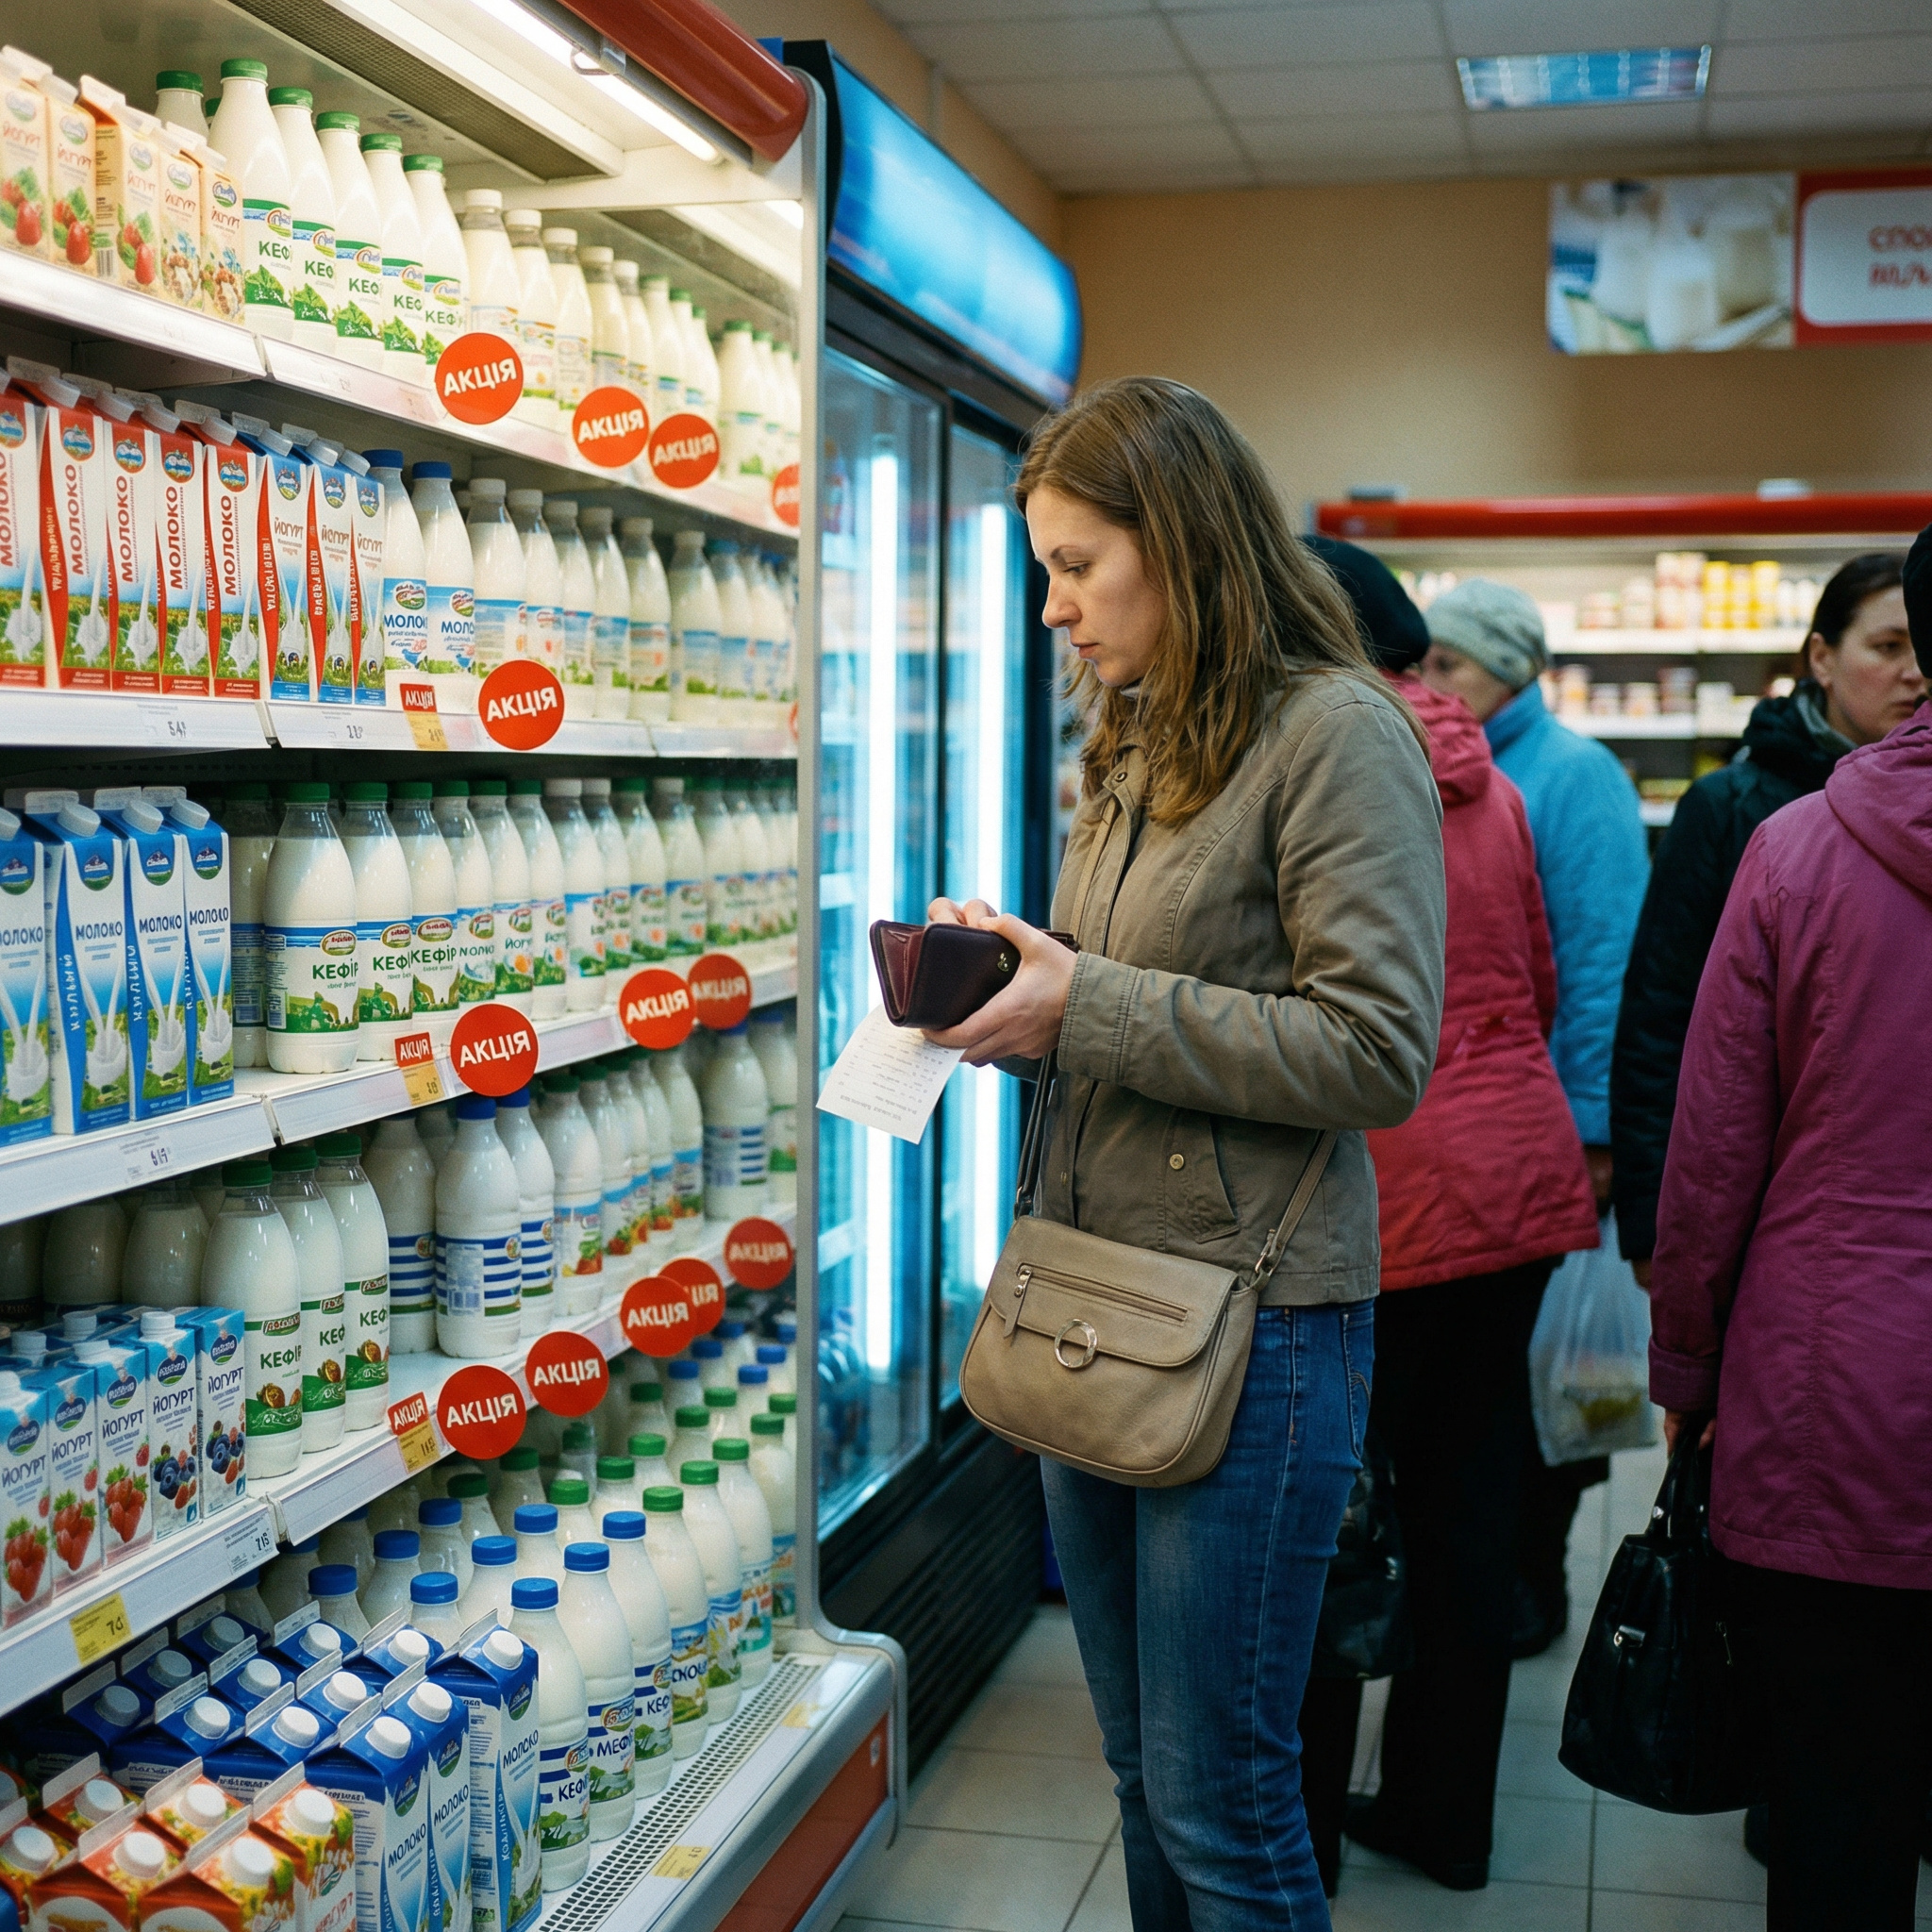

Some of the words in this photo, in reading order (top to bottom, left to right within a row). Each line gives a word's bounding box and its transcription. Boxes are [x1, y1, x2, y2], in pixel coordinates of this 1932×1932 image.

[443, 358, 518, 397] АКЦІЯ
[577, 408, 645, 444] АКЦІЯ
[653, 432, 717, 466] АКЦІЯ
[65, 464, 84, 575] МОЛОКО
[116, 475, 133, 583] МОЛОКО
[165, 486, 183, 590] МОЛОКО
[221, 495, 236, 596] МОЛОКО
[486, 686, 558, 723] АКЦІЯ
[75, 921, 123, 941] МОЛОКО
[139, 914, 182, 934] МОЛОКО
[625, 989, 690, 1024] АКЦІЯ
[458, 1029, 532, 1069] АКЦІЯ
[691, 1283, 719, 1307] ЦІЯ
[626, 1301, 690, 1329] АКЦІЯ
[208, 1366, 244, 1394] ЙОГУРТ
[533, 1357, 602, 1387] АКЦІЯ
[153, 1387, 195, 1415] ЙОГУРТ
[445, 1392, 519, 1428] АКЦІЯ
[102, 1409, 144, 1440] ЙОГУРТ
[51, 1431, 93, 1462] ЙОГУРТ
[1, 1454, 46, 1489] ЙОГУРТ
[433, 1784, 469, 1828] МОЛОКО
[388, 1823, 426, 1869] МОЛОКО
